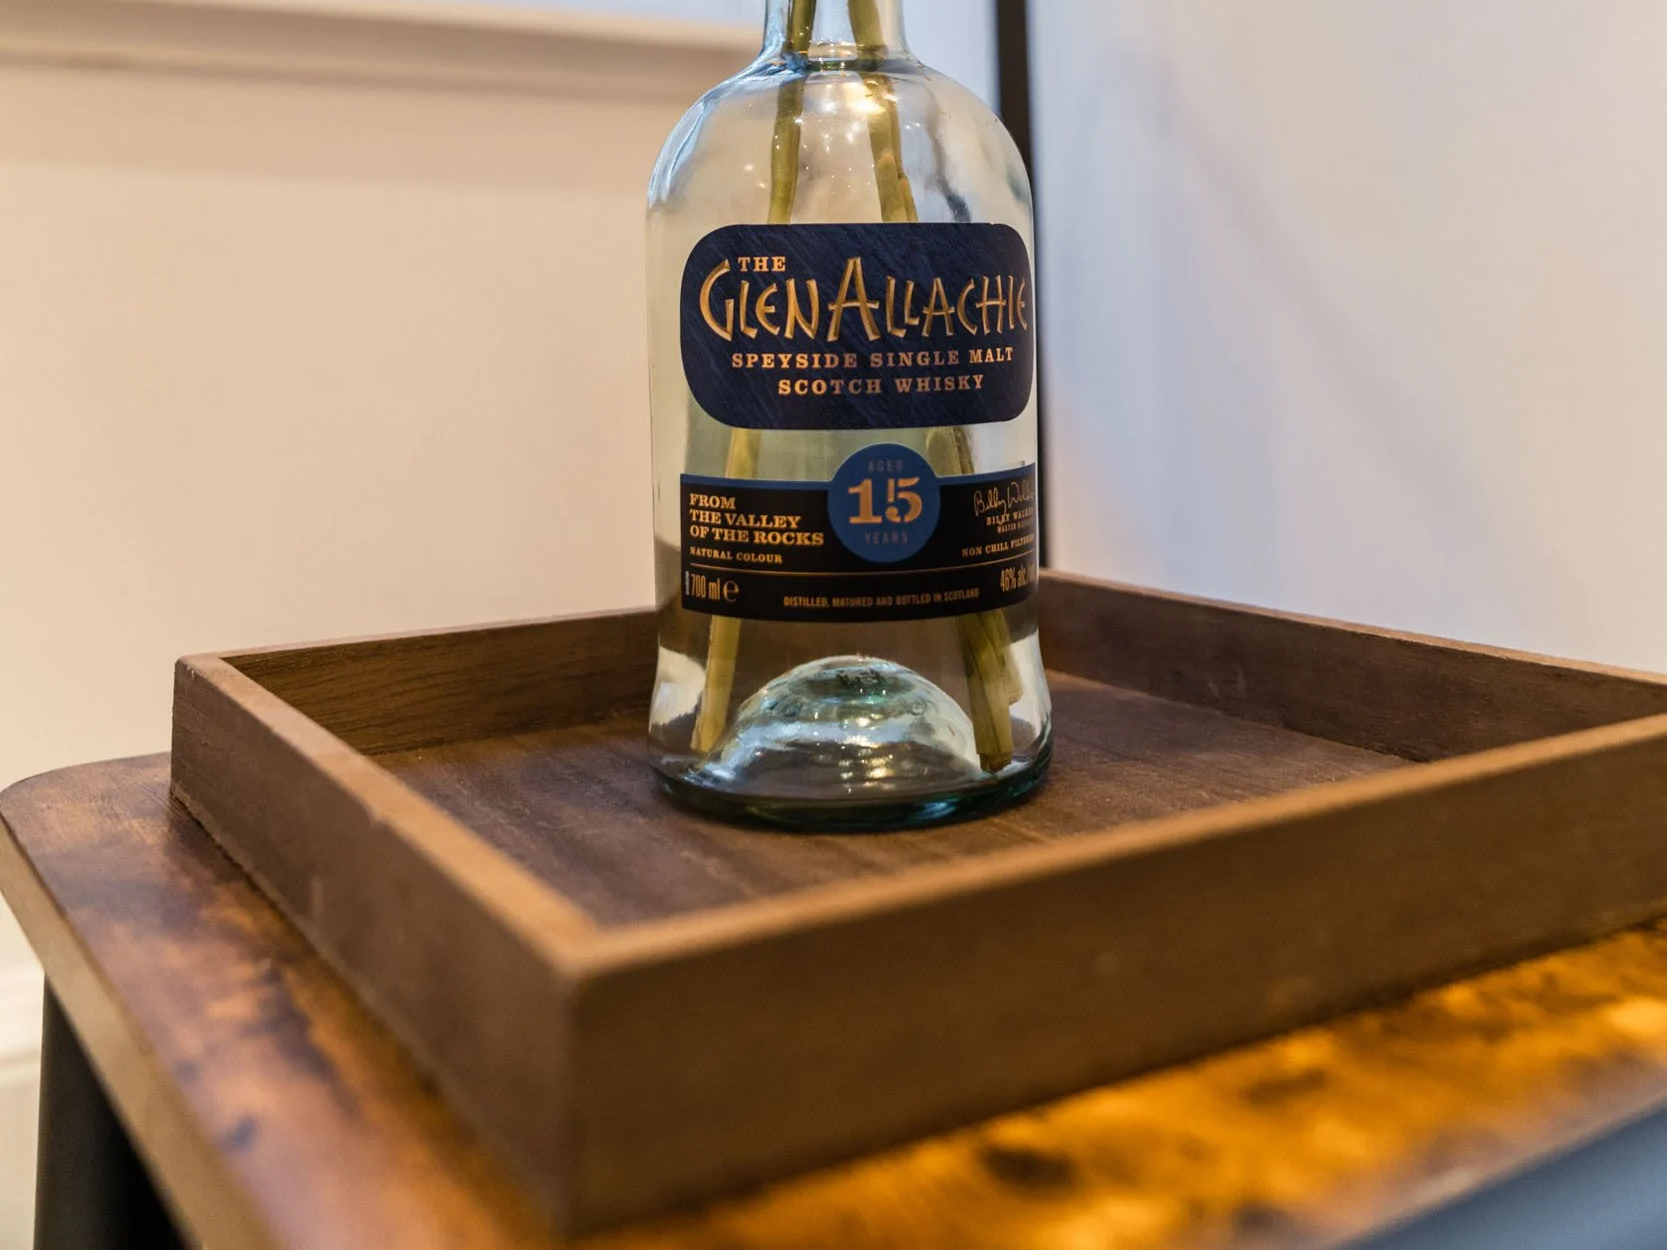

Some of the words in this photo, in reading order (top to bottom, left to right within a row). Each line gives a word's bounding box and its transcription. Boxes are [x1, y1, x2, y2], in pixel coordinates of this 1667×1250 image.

[738, 256, 786, 272] THE
[732, 353, 858, 368] SPEYSIDE
[870, 350, 960, 367] SINGLE
[968, 347, 1013, 364] MALT
[778, 379, 881, 395] SCOTCH
[895, 374, 984, 393] WHISKY
[868, 459, 903, 472] AGED
[689, 493, 736, 509] FROM
[847, 477, 923, 524] 15
[690, 509, 721, 524] THE
[725, 513, 801, 529] VALLEY
[690, 525, 709, 539] OF
[712, 528, 749, 543] THE
[754, 531, 825, 546] ROCKS
[865, 531, 908, 545] YEARS
[690, 546, 733, 560] NATURAL
[736, 553, 783, 564] COLOUR
[962, 547, 982, 557] NON
[985, 541, 1009, 554] CHILL
[691, 573, 706, 599] 700
[709, 578, 720, 600] ml
[832, 596, 873, 607] MATURED
[875, 596, 892, 606] AND
[895, 595, 930, 606] BOTTLED
[933, 594, 943, 603] IN
[944, 587, 980, 602] SCOTLAND
